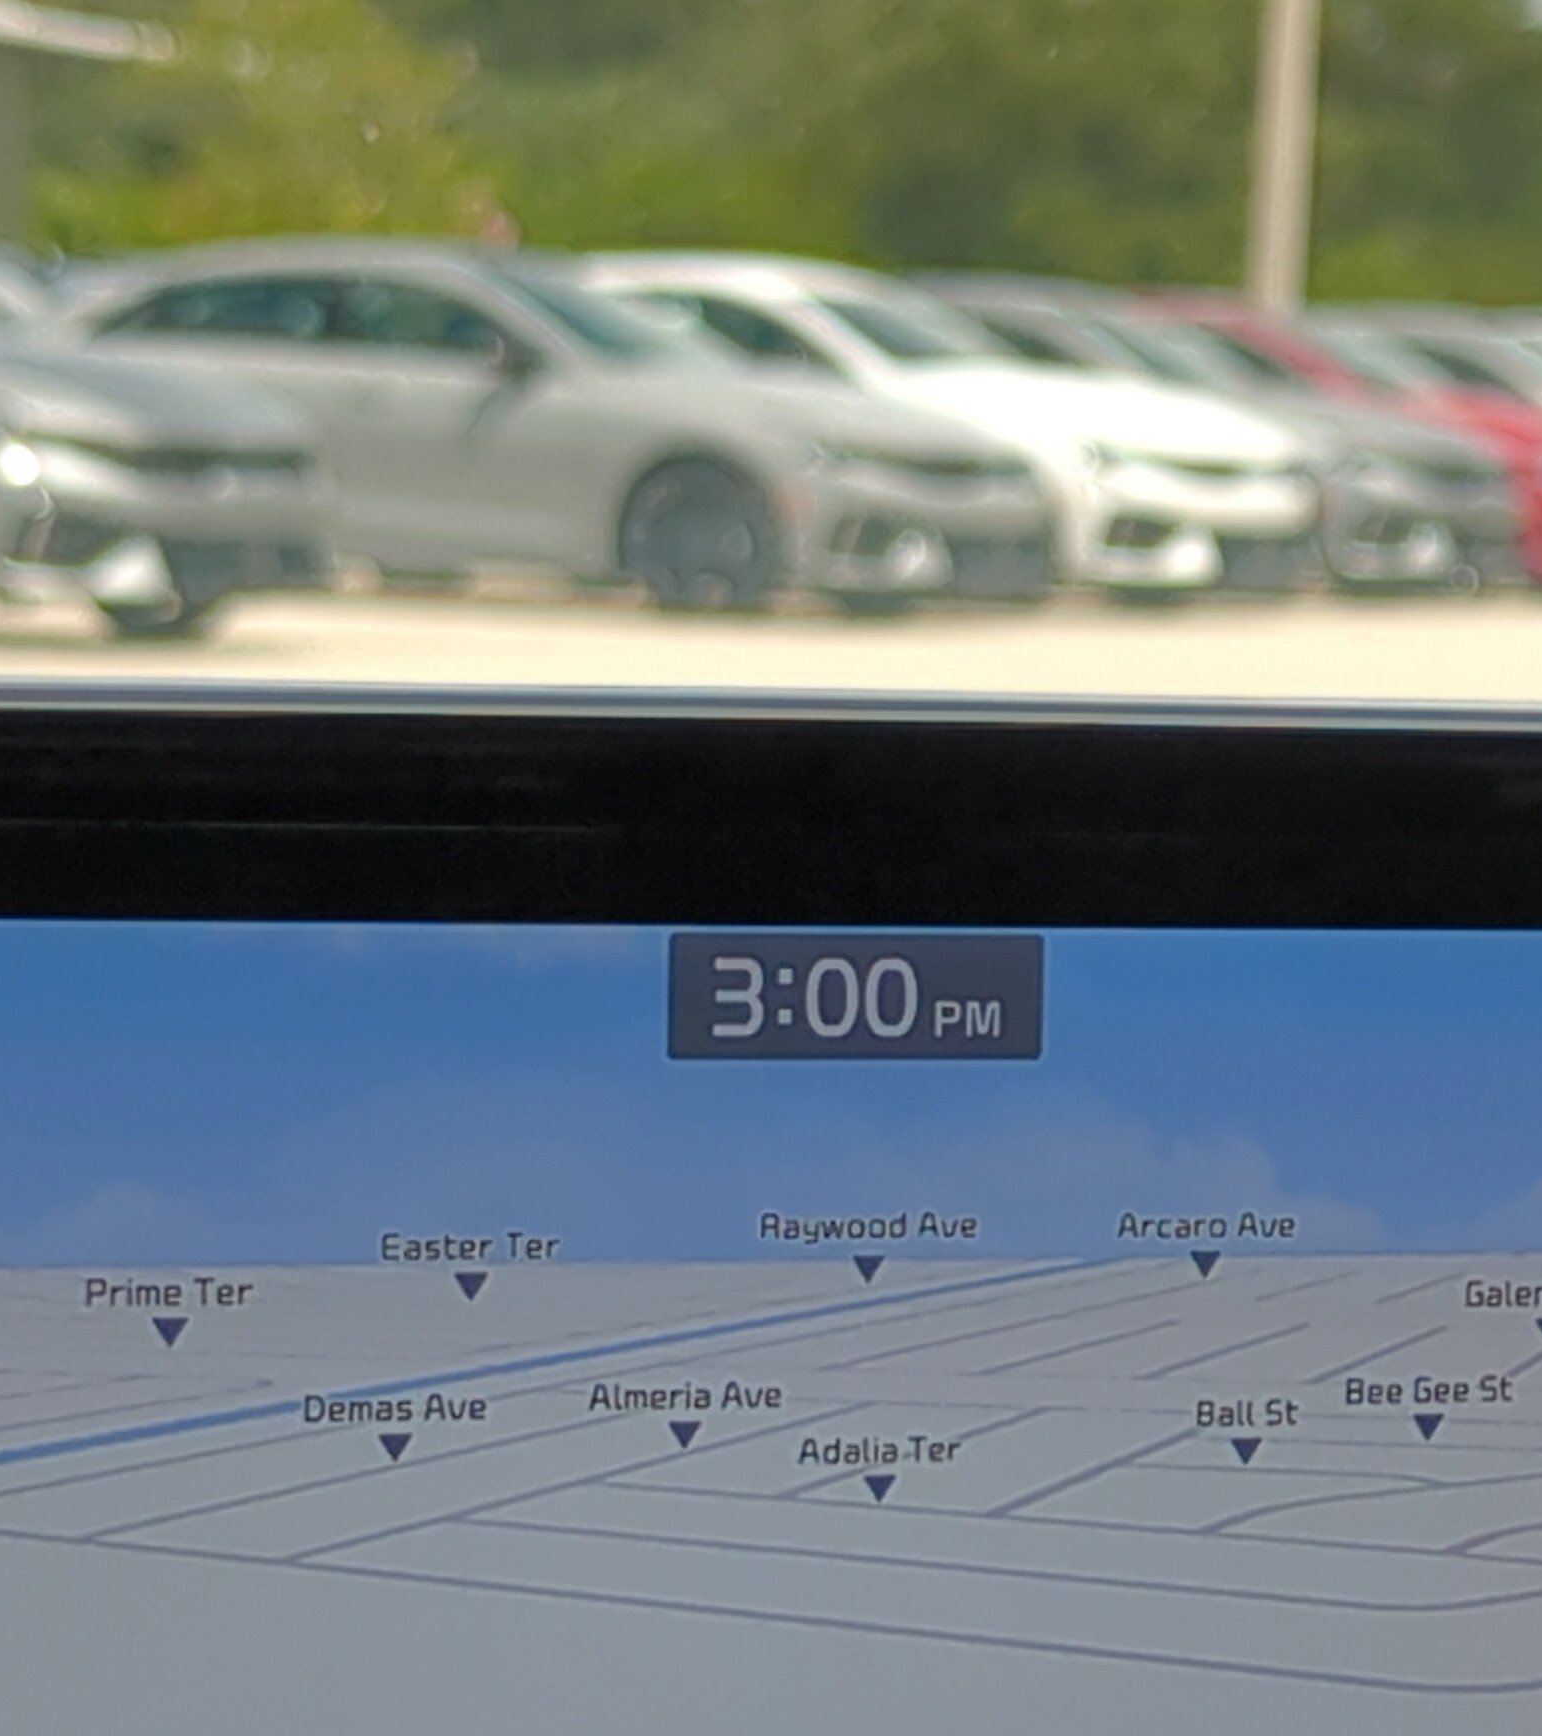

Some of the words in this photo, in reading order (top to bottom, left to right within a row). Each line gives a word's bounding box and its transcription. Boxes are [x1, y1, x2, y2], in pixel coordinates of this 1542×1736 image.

[711, 956, 918, 1037] 3:00
[934, 1001, 1000, 1037] PM
[760, 1212, 906, 1244] Raywood
[919, 1213, 978, 1239] Ave
[1117, 1212, 1227, 1239] Arcaro
[1238, 1212, 1295, 1239] Ave
[381, 1233, 491, 1260] Easter
[508, 1232, 560, 1258] Ter
[85, 1278, 181, 1306] Prime
[194, 1277, 252, 1305] Ter
[589, 1382, 710, 1410] Almeria
[721, 1382, 781, 1409] Ave
[1346, 1379, 1402, 1405] Bee
[1414, 1377, 1469, 1404] Gee
[1479, 1376, 1512, 1401] St
[304, 1395, 412, 1422] Demas
[424, 1394, 487, 1420] Ave
[1196, 1402, 1254, 1427] Ball
[1265, 1400, 1298, 1425] St
[798, 1439, 900, 1466] Adalia
[911, 1437, 960, 1464] Ter
